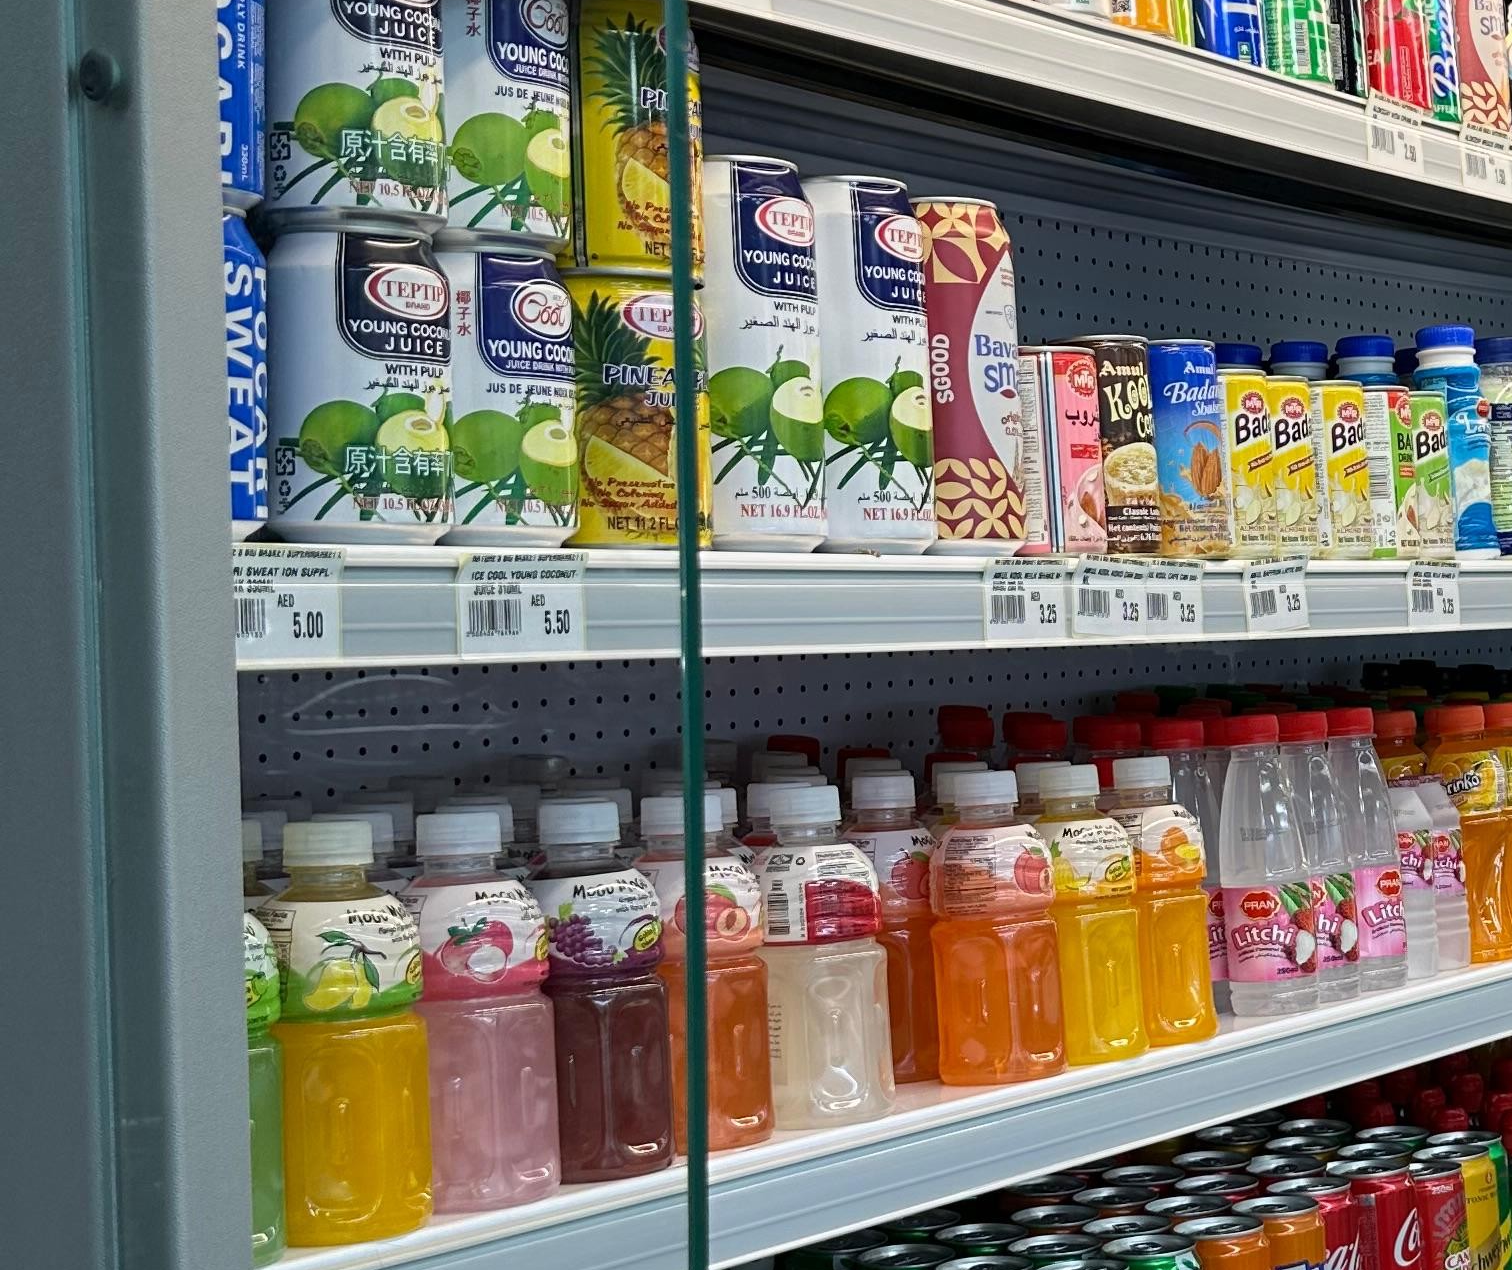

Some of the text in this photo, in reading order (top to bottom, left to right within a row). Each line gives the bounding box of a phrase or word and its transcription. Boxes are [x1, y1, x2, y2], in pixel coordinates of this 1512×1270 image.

[343, 0, 402, 20] YOUNG
[379, 21, 437, 47] JUICE
[236, 22, 247, 70] DRINK
[497, 41, 547, 66] YOUNG
[380, 47, 412, 63] WITH
[513, 63, 537, 77] JUICE
[494, 85, 515, 98] JUS
[516, 87, 529, 100] DE
[744, 249, 789, 268] YOUNG
[773, 273, 817, 291] JUICE
[864, 266, 908, 282] YOUNG
[381, 280, 444, 303] TEPTIP
[455, 289, 472, 337] 椰子水
[774, 301, 799, 314] WITH
[349, 317, 407, 336] YOUNG
[892, 314, 914, 327] WITH
[384, 336, 444, 356] JUICE
[489, 338, 542, 358] YOUNG
[385, 363, 444, 379] WITH PULP
[505, 359, 532, 371] JUICE
[486, 383, 552, 398] JUS DE JEUNE
[873, 490, 892, 503] 500
[741, 504, 791, 519] NET 16.9
[863, 508, 912, 522] NET 16.9
[607, 516, 657, 530] NET 11.2
[281, 567, 299, 578] ION
[277, 594, 295, 609] AED
[531, 595, 546, 608] AED
[1040, 604, 1057, 624] 3.25
[1123, 602, 1139, 622] 3.25
[1180, 604, 1196, 623] 3.25
[293, 611, 324, 640] 5.00
[544, 609, 571, 635] 5.50
[1243, 899, 1276, 912] PRAN
[1233, 924, 1294, 946] Litchi
